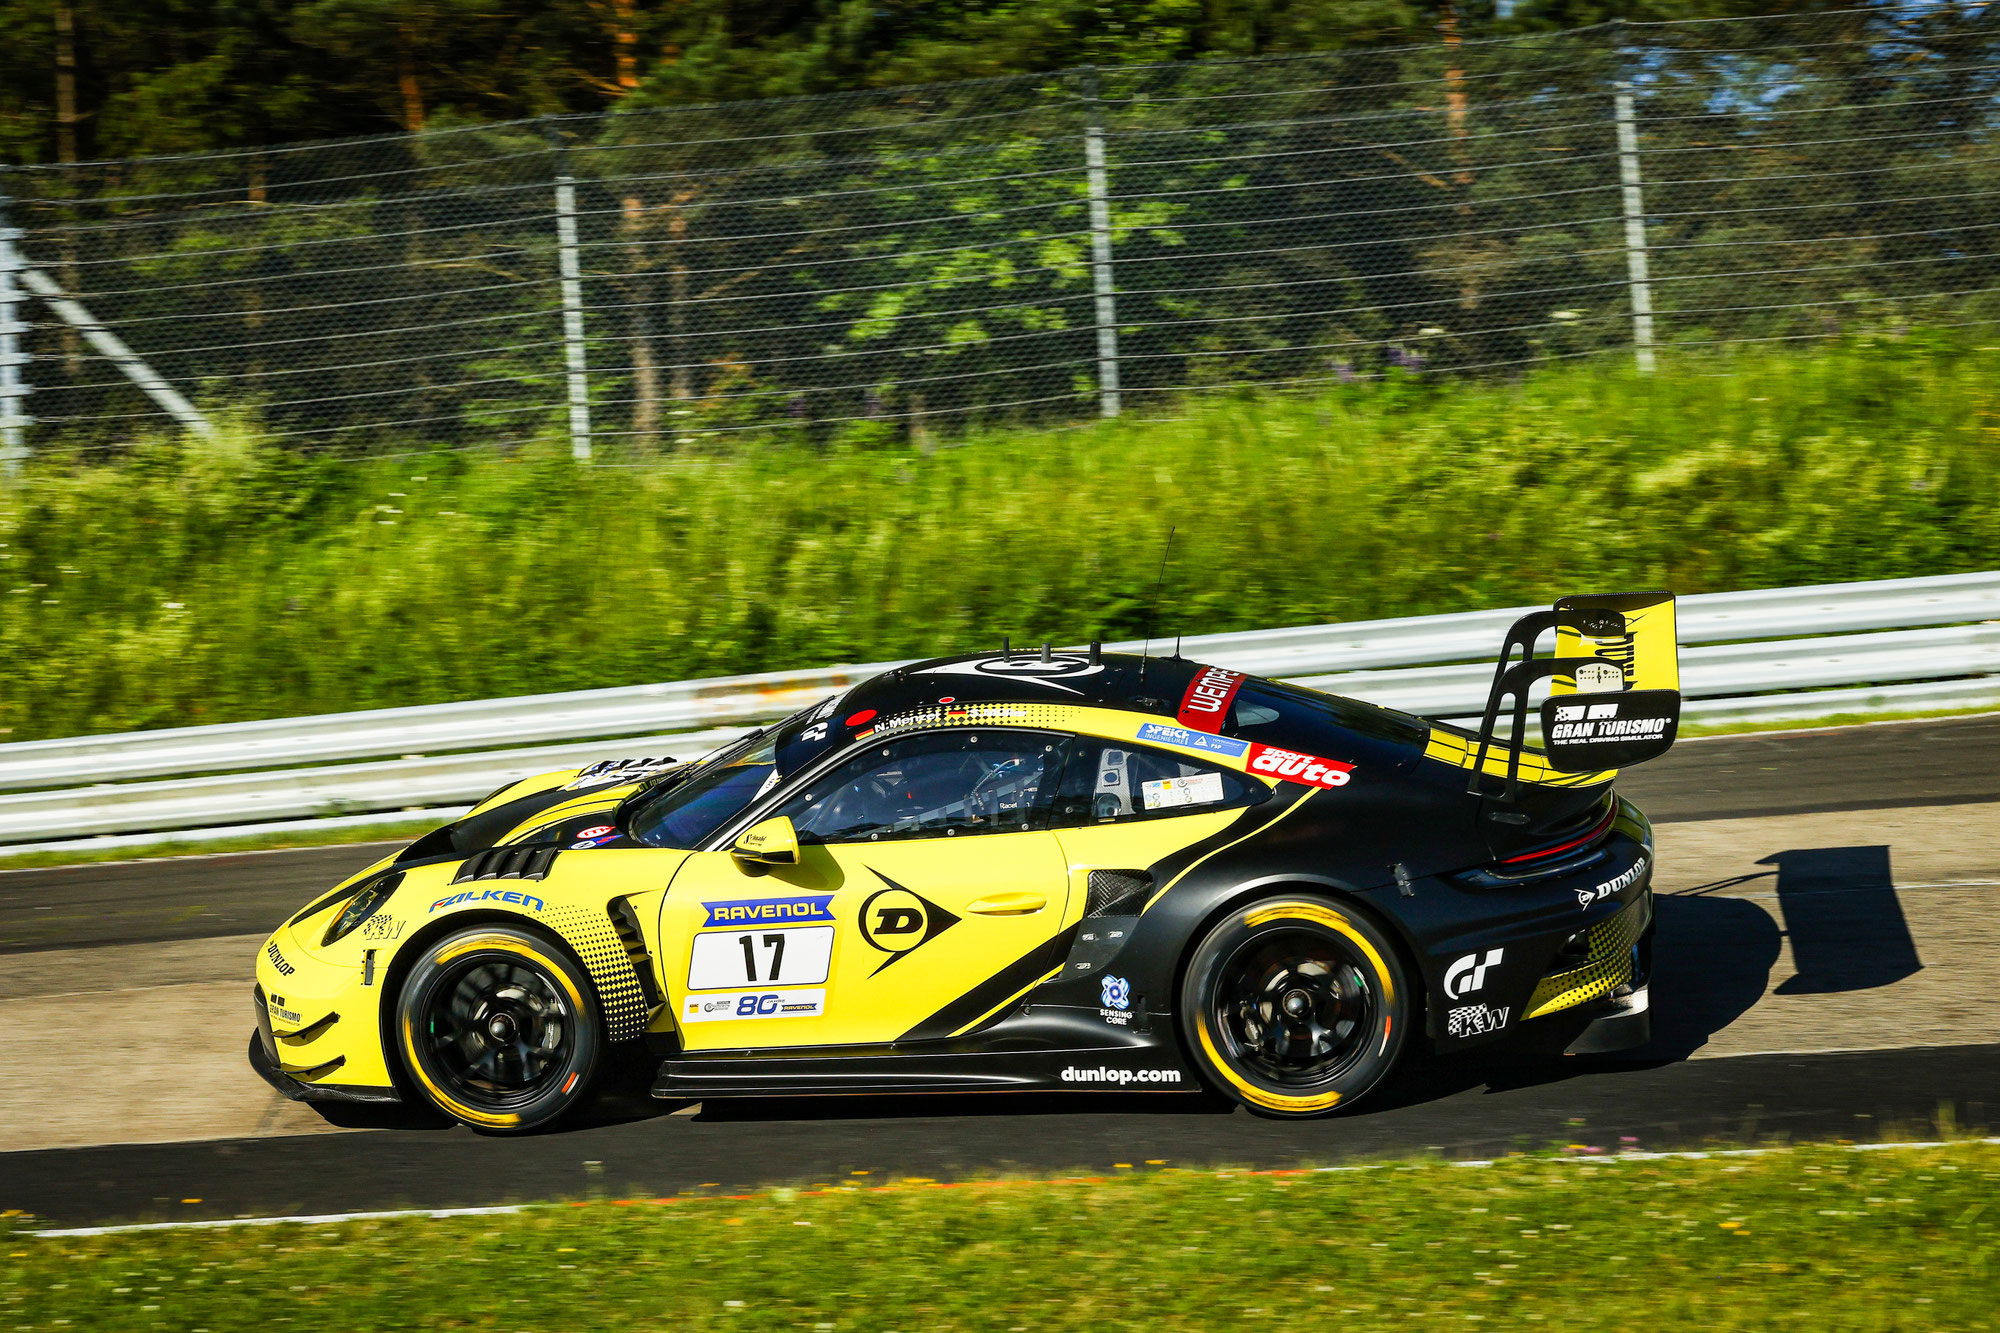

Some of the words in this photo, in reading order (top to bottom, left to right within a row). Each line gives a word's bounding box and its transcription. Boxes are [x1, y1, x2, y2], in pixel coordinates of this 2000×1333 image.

[874, 711, 940, 733] N.Menzel
[1552, 722, 1595, 739] GRAN
[1569, 737, 1588, 745] REAL
[1589, 736, 1620, 744] DRIVING
[1620, 733, 1663, 742] SIMULATOR
[1261, 747, 1316, 765] sport
[1252, 753, 1351, 787] auto
[1596, 856, 1646, 900] DUNLOP
[428, 890, 544, 913] FALKEN
[713, 902, 824, 921] RAVENOL
[873, 908, 924, 935] D
[267, 943, 296, 976] DUNLOP
[738, 933, 786, 982] 17
[736, 994, 779, 1016] 80
[1099, 1008, 1133, 1019] SENSING
[1106, 1017, 1127, 1026] CORE
[1459, 1006, 1511, 1038] KW
[1061, 1066, 1181, 1085] dunlop.com
